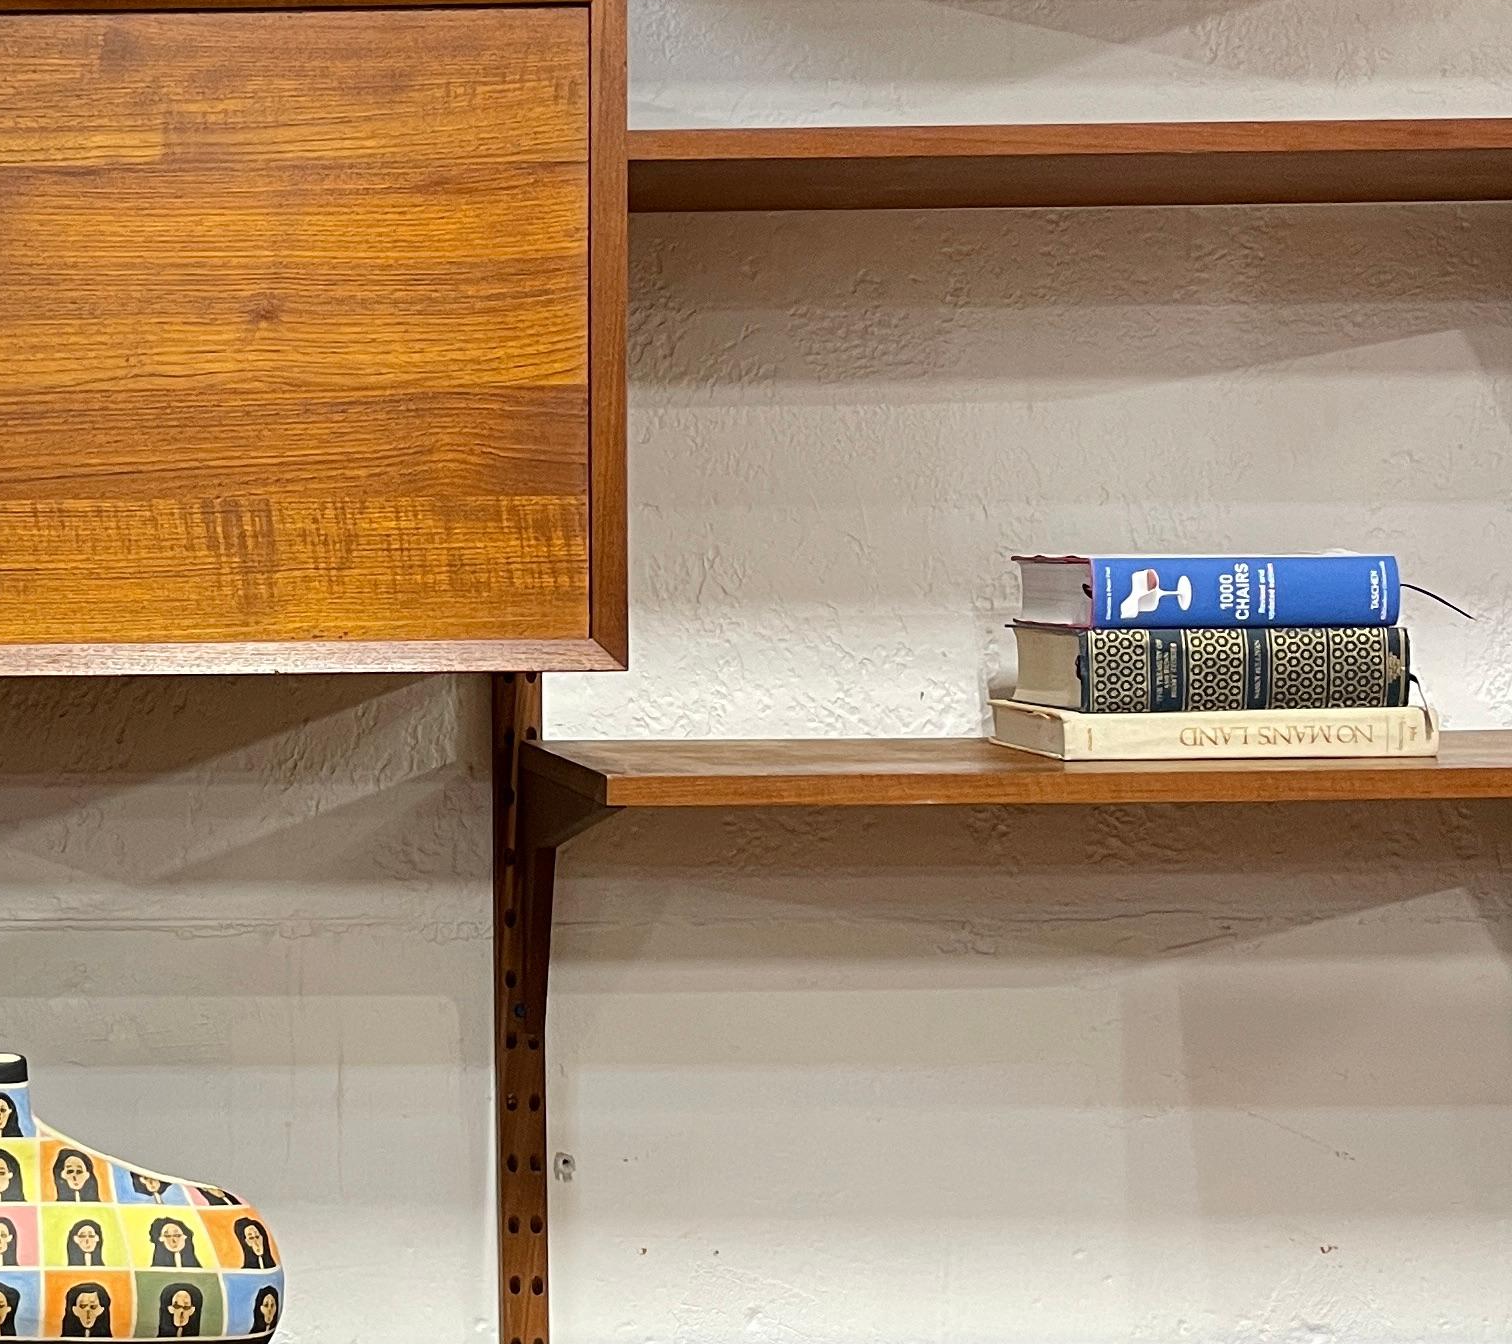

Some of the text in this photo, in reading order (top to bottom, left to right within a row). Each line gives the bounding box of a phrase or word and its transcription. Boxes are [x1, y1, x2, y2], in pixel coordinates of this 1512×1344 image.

[1219, 574, 1234, 610] 1000
[1234, 563, 1250, 620] CHAIRS
[1370, 570, 1379, 610] TASCHEN
[1178, 726, 1249, 747] LAND
[1336, 724, 1374, 744] NO
